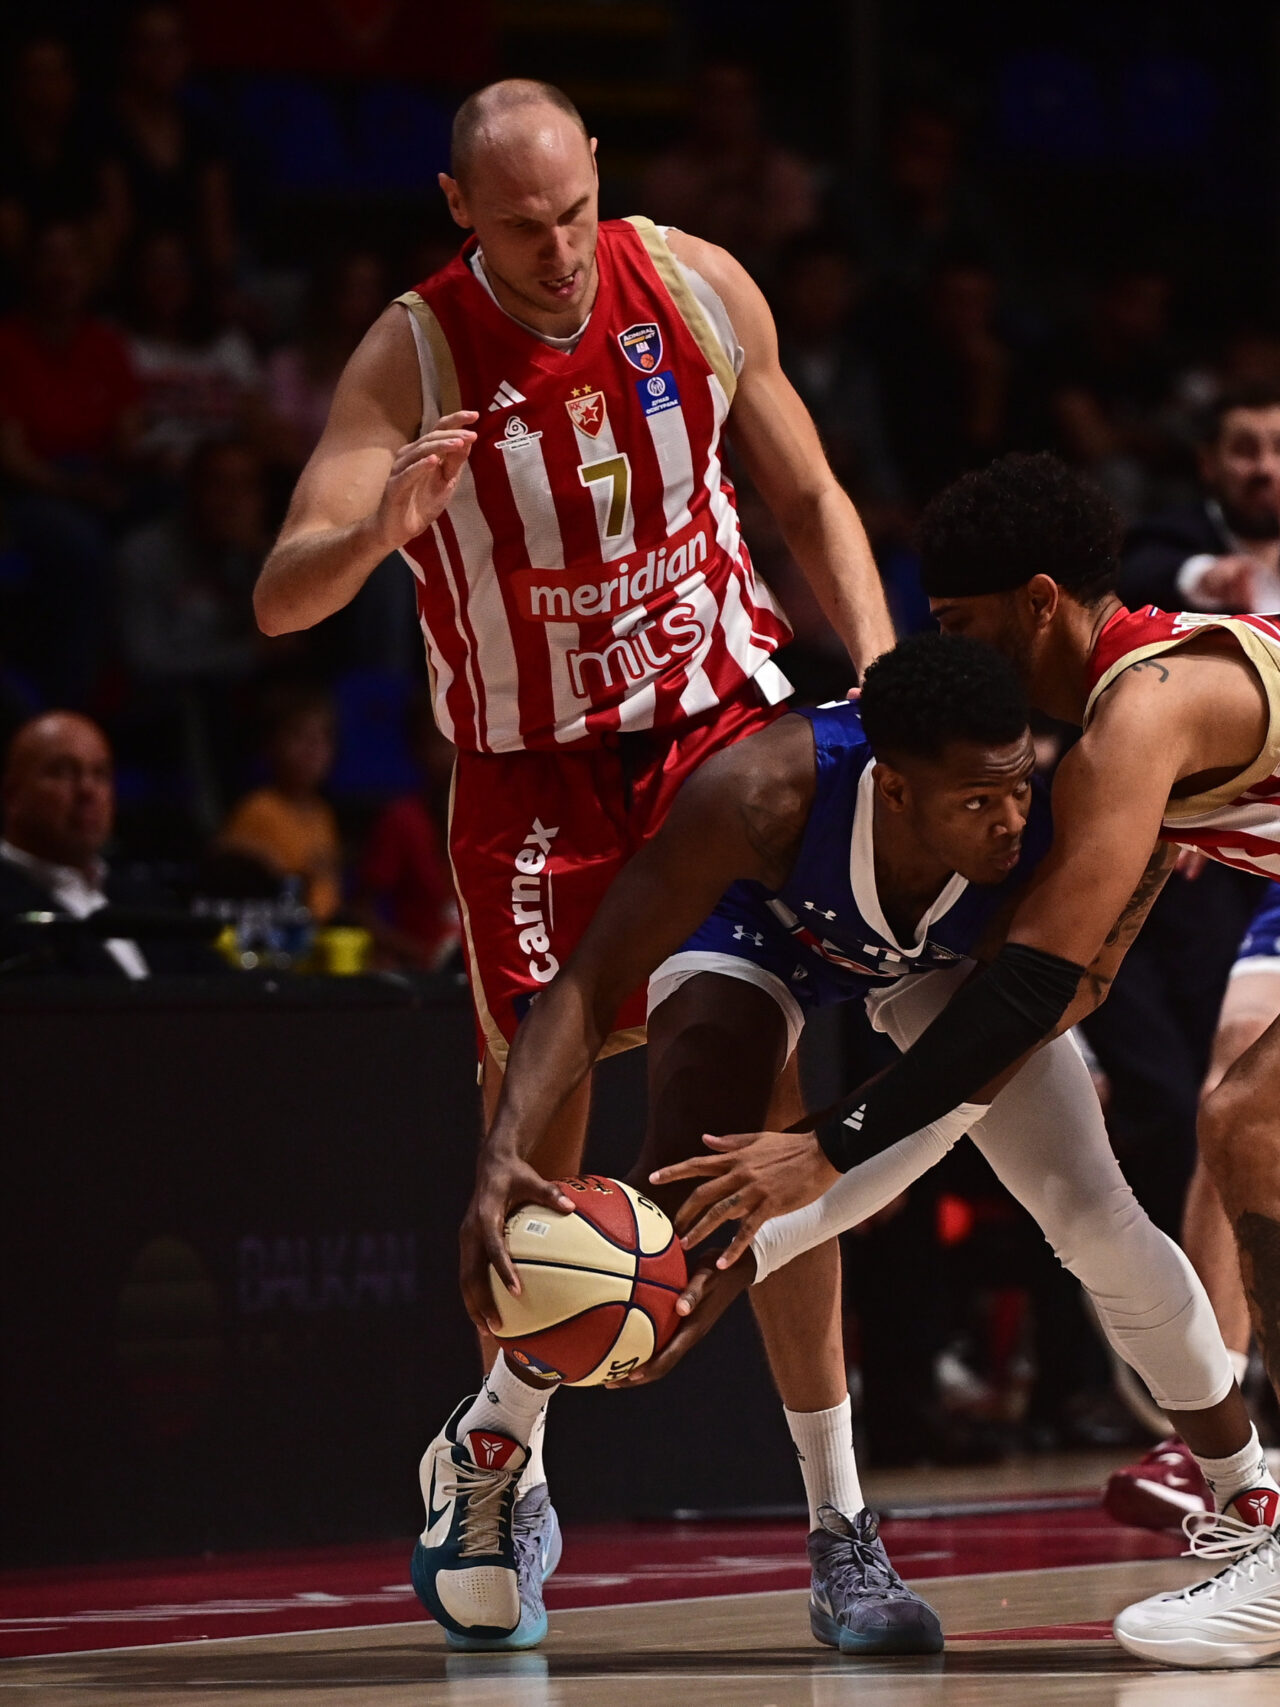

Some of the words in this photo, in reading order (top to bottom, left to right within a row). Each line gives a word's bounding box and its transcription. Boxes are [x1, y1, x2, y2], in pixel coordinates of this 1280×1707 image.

[577, 452, 632, 538] 7
[530, 530, 708, 616] meridian
[567, 603, 705, 697] mts
[511, 817, 560, 983] carnex
